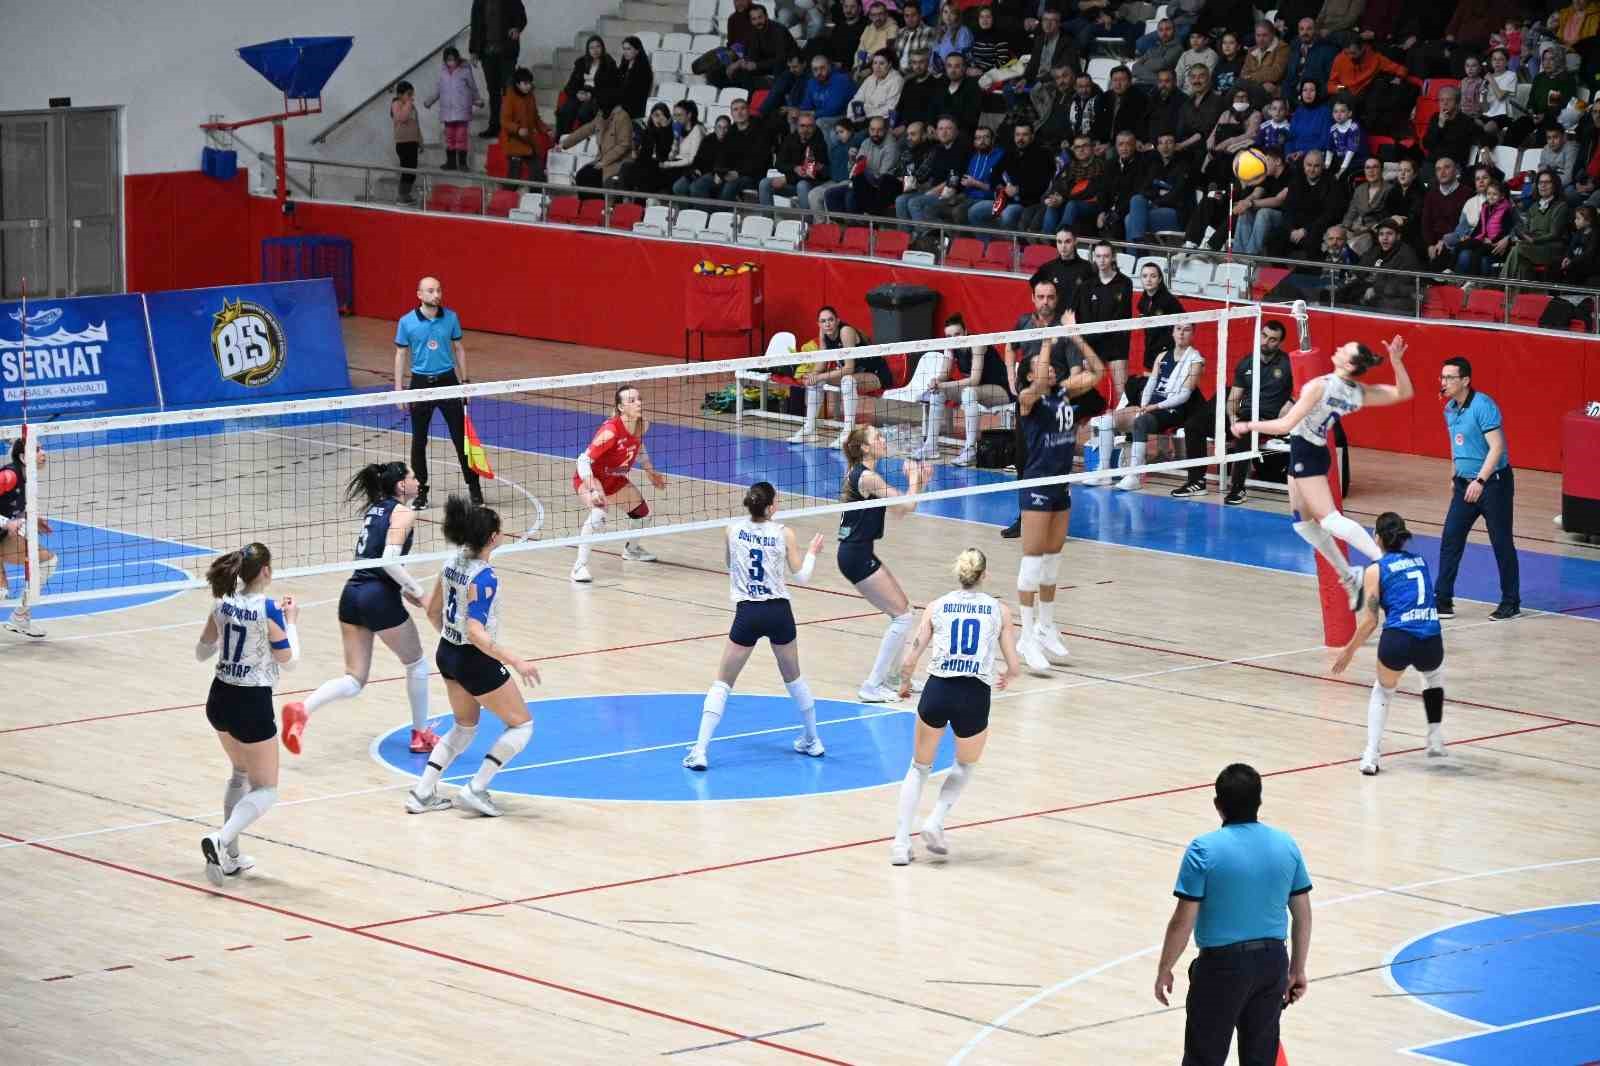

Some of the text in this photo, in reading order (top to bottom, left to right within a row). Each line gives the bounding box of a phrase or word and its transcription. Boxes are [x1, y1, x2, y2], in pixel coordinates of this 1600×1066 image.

[2, 345, 102, 382] SERHAT
[218, 316, 271, 377] BES
[1056, 401, 1074, 433] 19
[748, 549, 764, 582] 3
[1406, 570, 1425, 606] 7
[223, 621, 247, 663] 17
[950, 617, 980, 656] 10
